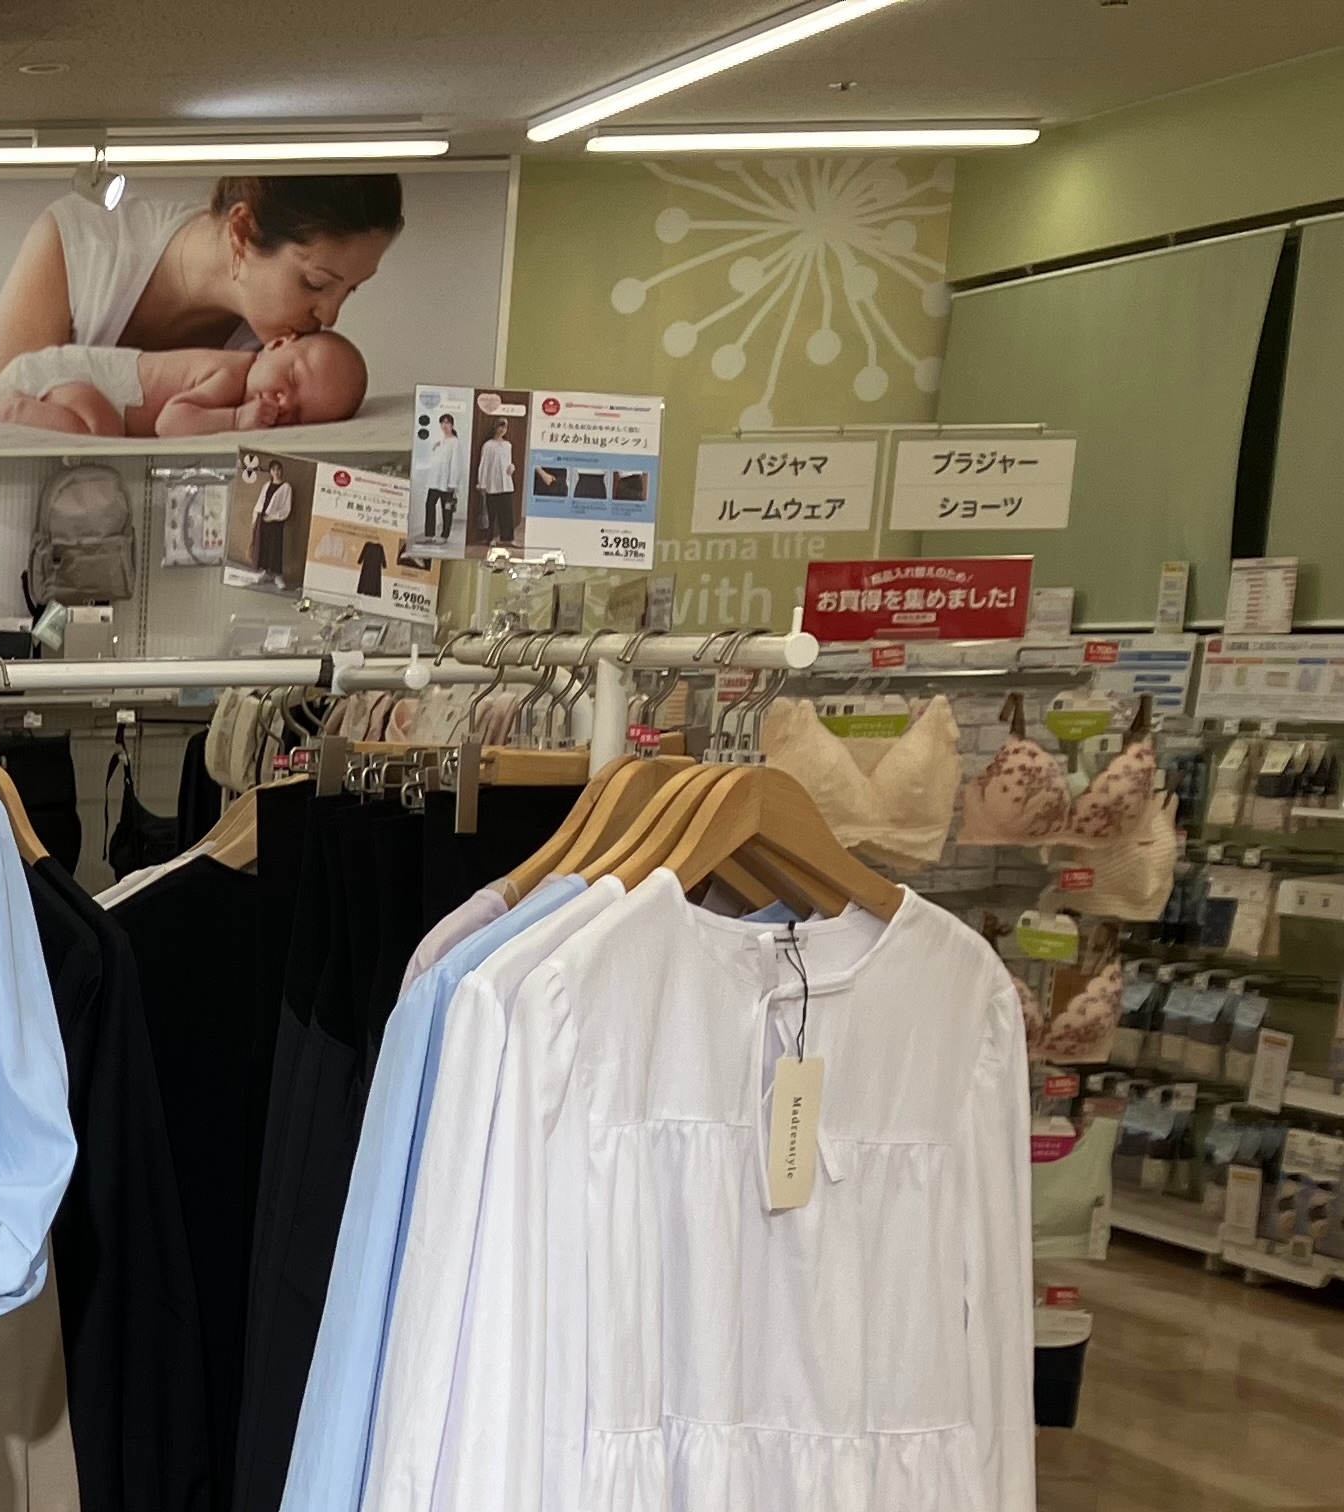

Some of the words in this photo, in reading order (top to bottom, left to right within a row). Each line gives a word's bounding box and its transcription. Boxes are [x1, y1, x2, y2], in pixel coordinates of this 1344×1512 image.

[742, 452, 829, 477] パジャマ
[932, 450, 1039, 476] ブラジャー
[718, 496, 846, 521] ルームウェア
[938, 495, 1024, 520] ショーツ
[657, 537, 758, 562] mama
[772, 533, 826, 560] life
[786, 1096, 803, 1180] Madresstyle
